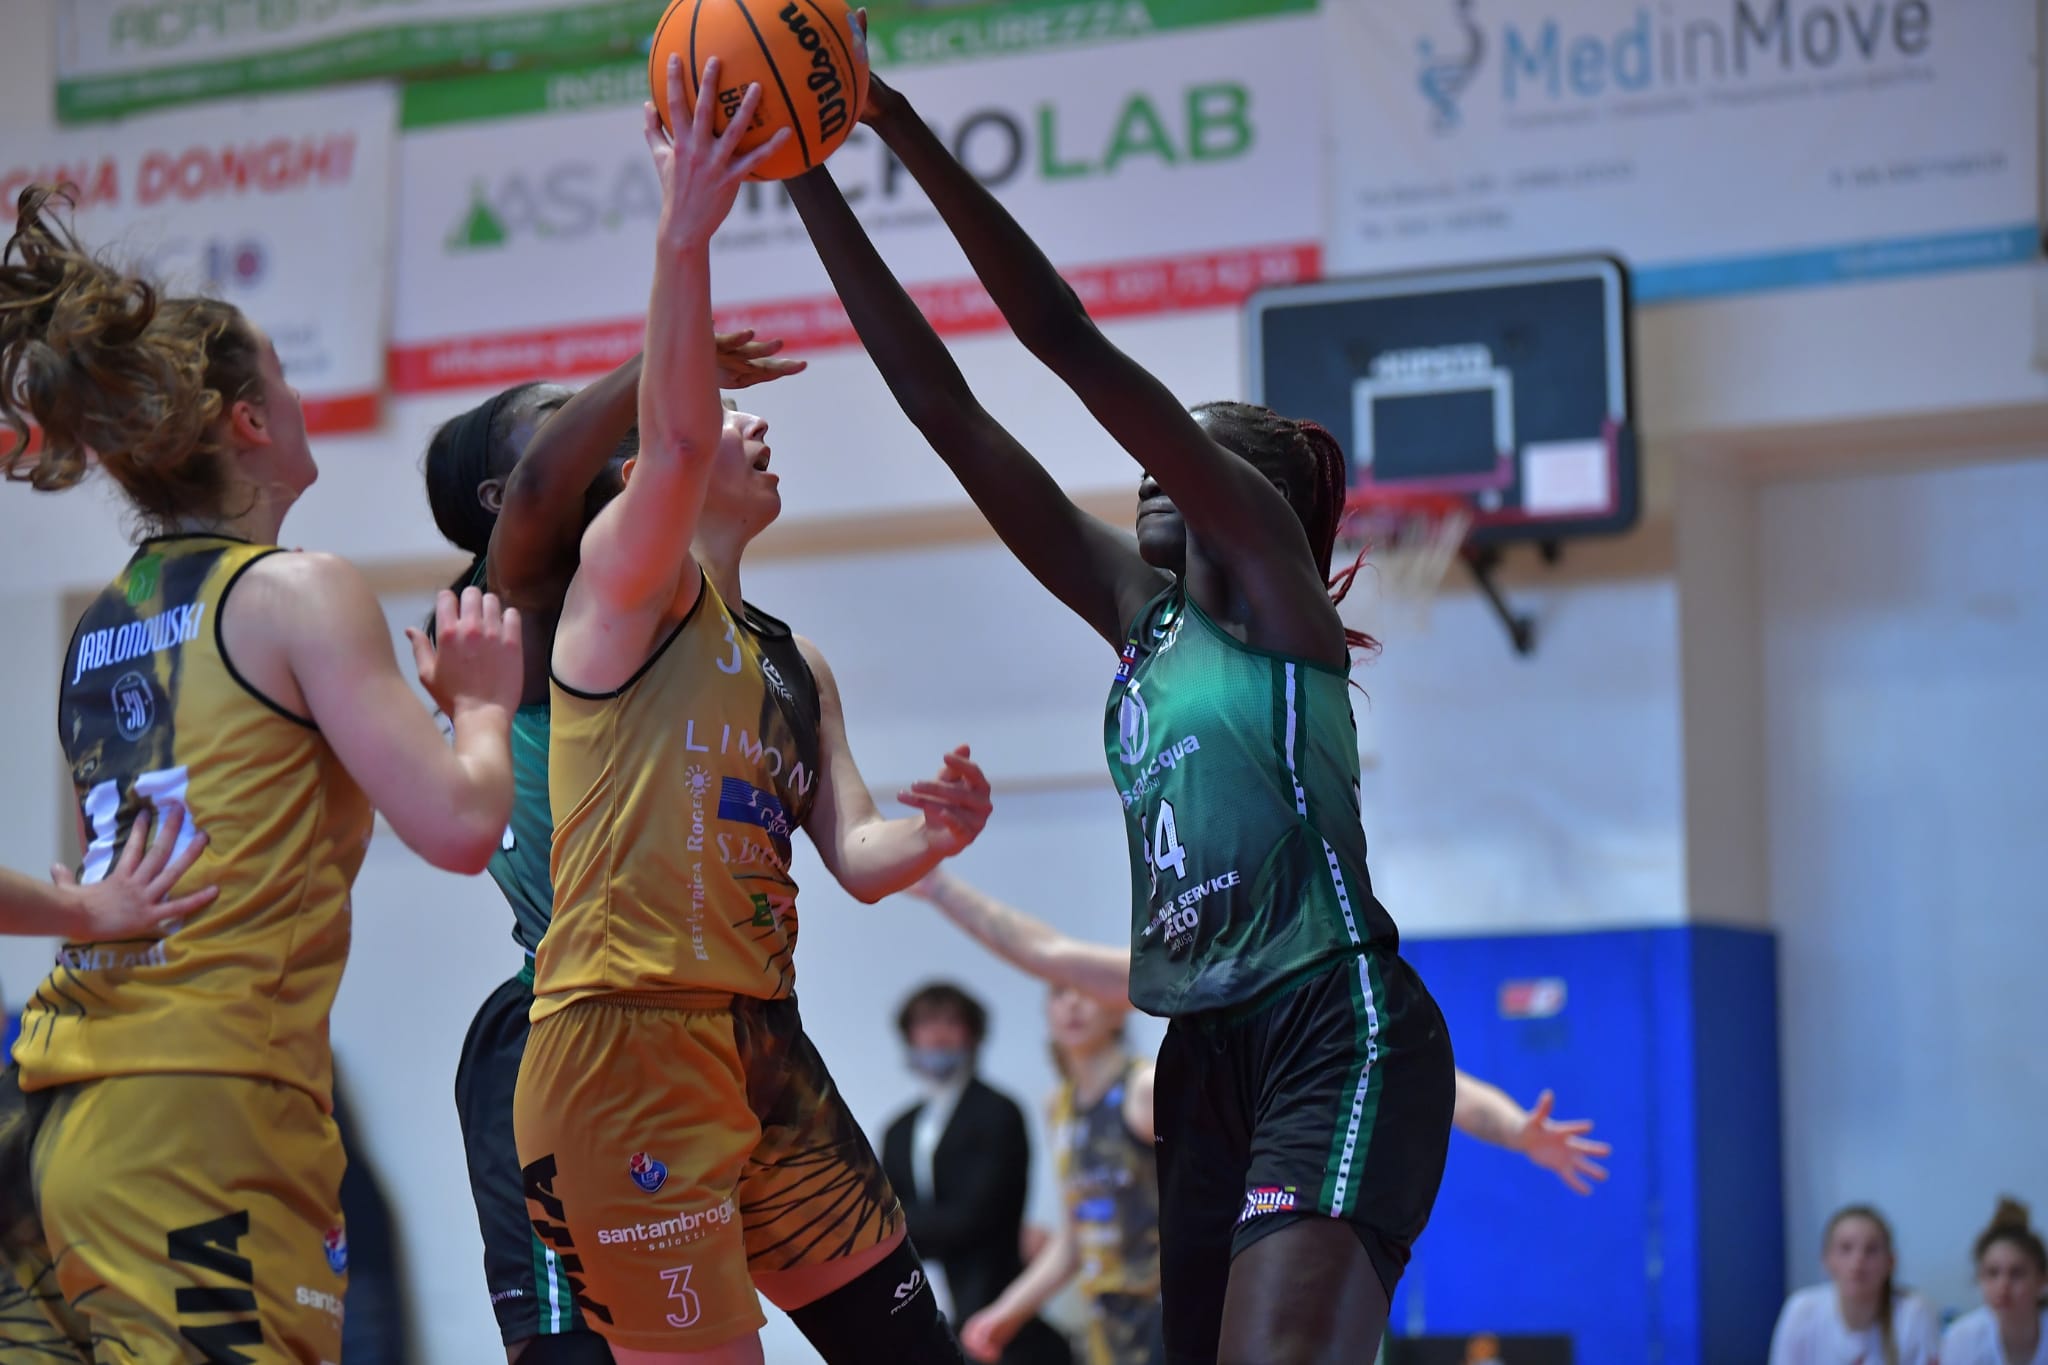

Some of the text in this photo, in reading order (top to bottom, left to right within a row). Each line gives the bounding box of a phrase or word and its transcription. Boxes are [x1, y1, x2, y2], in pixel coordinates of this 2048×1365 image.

[780, 2, 848, 144] Wilson
[1502, 0, 1932, 102] MedinMove
[72, 602, 205, 686] JABLONOWSKI
[684, 719, 814, 797] LIMON
[1177, 870, 1241, 910] SERVICE
[597, 1196, 736, 1245] santambrog
[648, 1229, 706, 1251] salotti
[659, 1264, 701, 1328] 3
